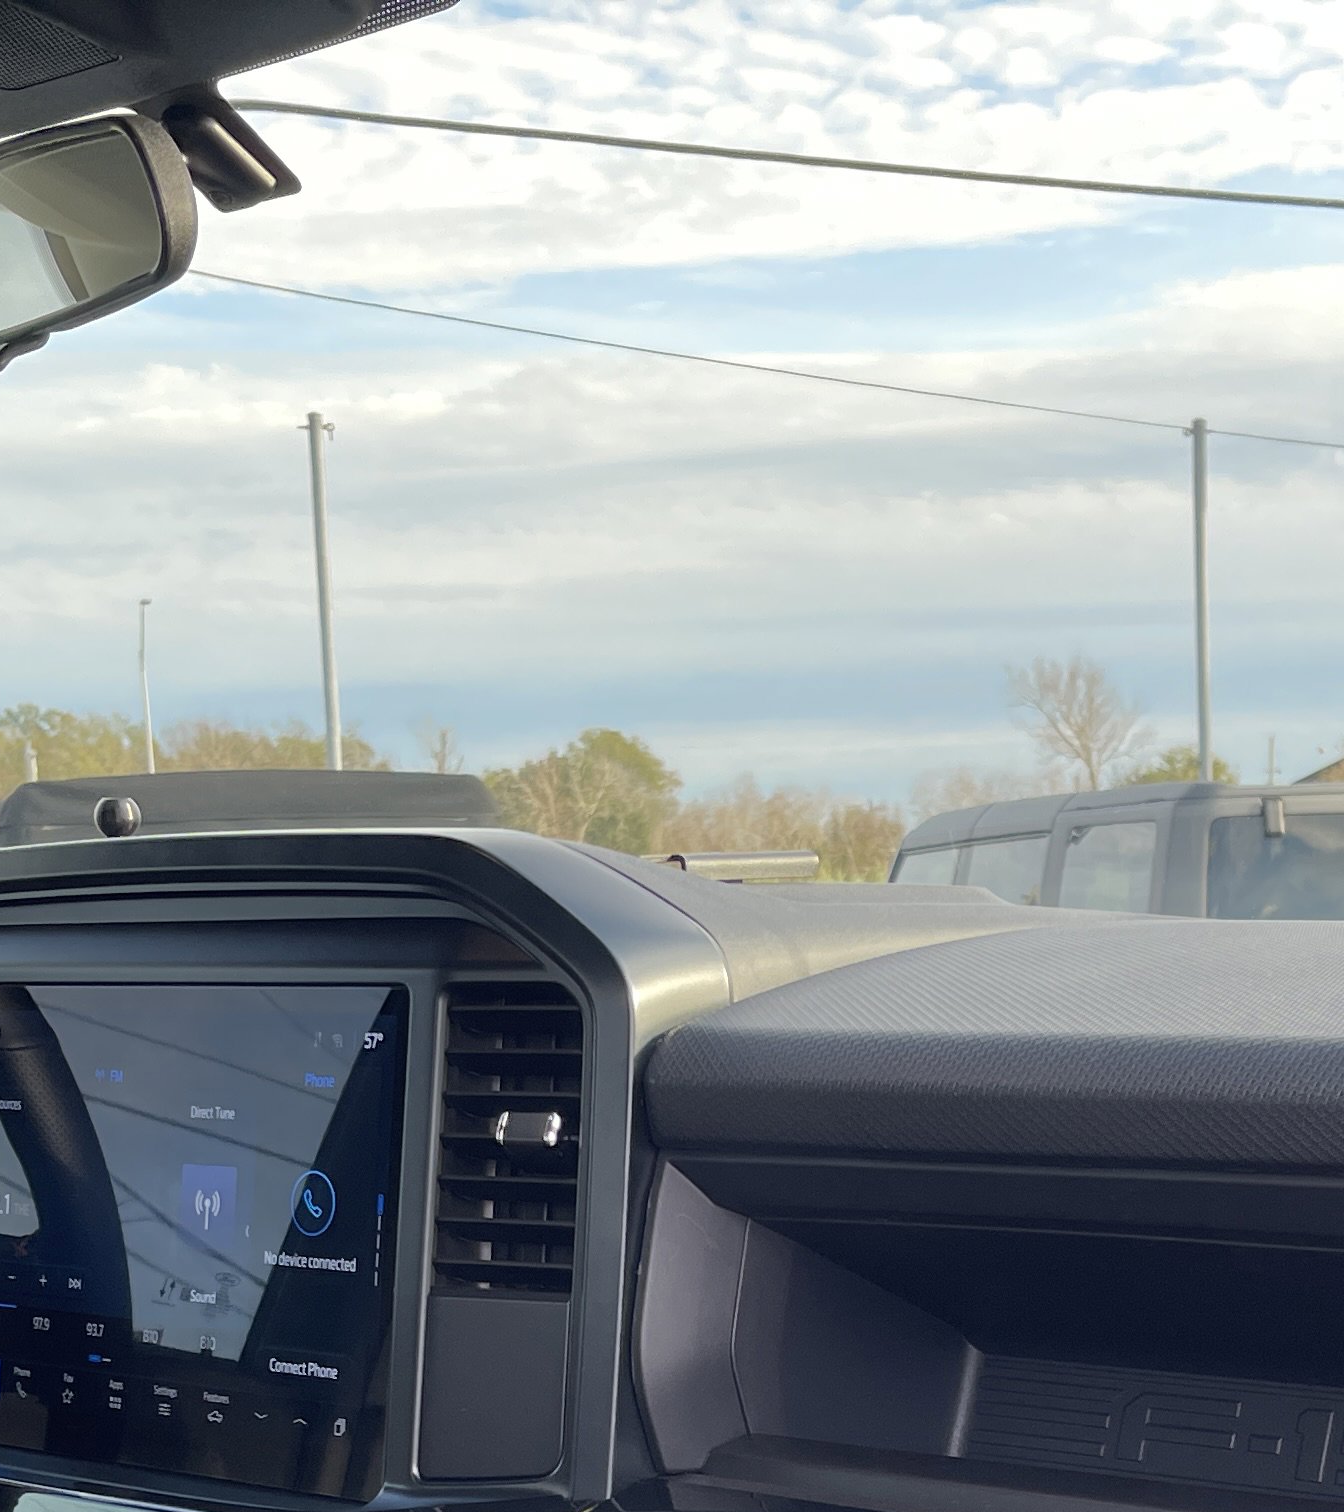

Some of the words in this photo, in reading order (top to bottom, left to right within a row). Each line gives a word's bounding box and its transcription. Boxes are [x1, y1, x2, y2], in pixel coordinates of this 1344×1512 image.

[110, 1068, 124, 1083] FM
[304, 1072, 336, 1089] Phone
[190, 1105, 213, 1120] Direct
[214, 1106, 236, 1121] Tune
[264, 1250, 277, 1265] No
[278, 1251, 307, 1268] device
[308, 1256, 356, 1273] connected
[189, 1289, 217, 1305] Sound
[85, 1322, 105, 1338] 93.7
[269, 1357, 307, 1376] Connect
[307, 1362, 338, 1380] Phone
